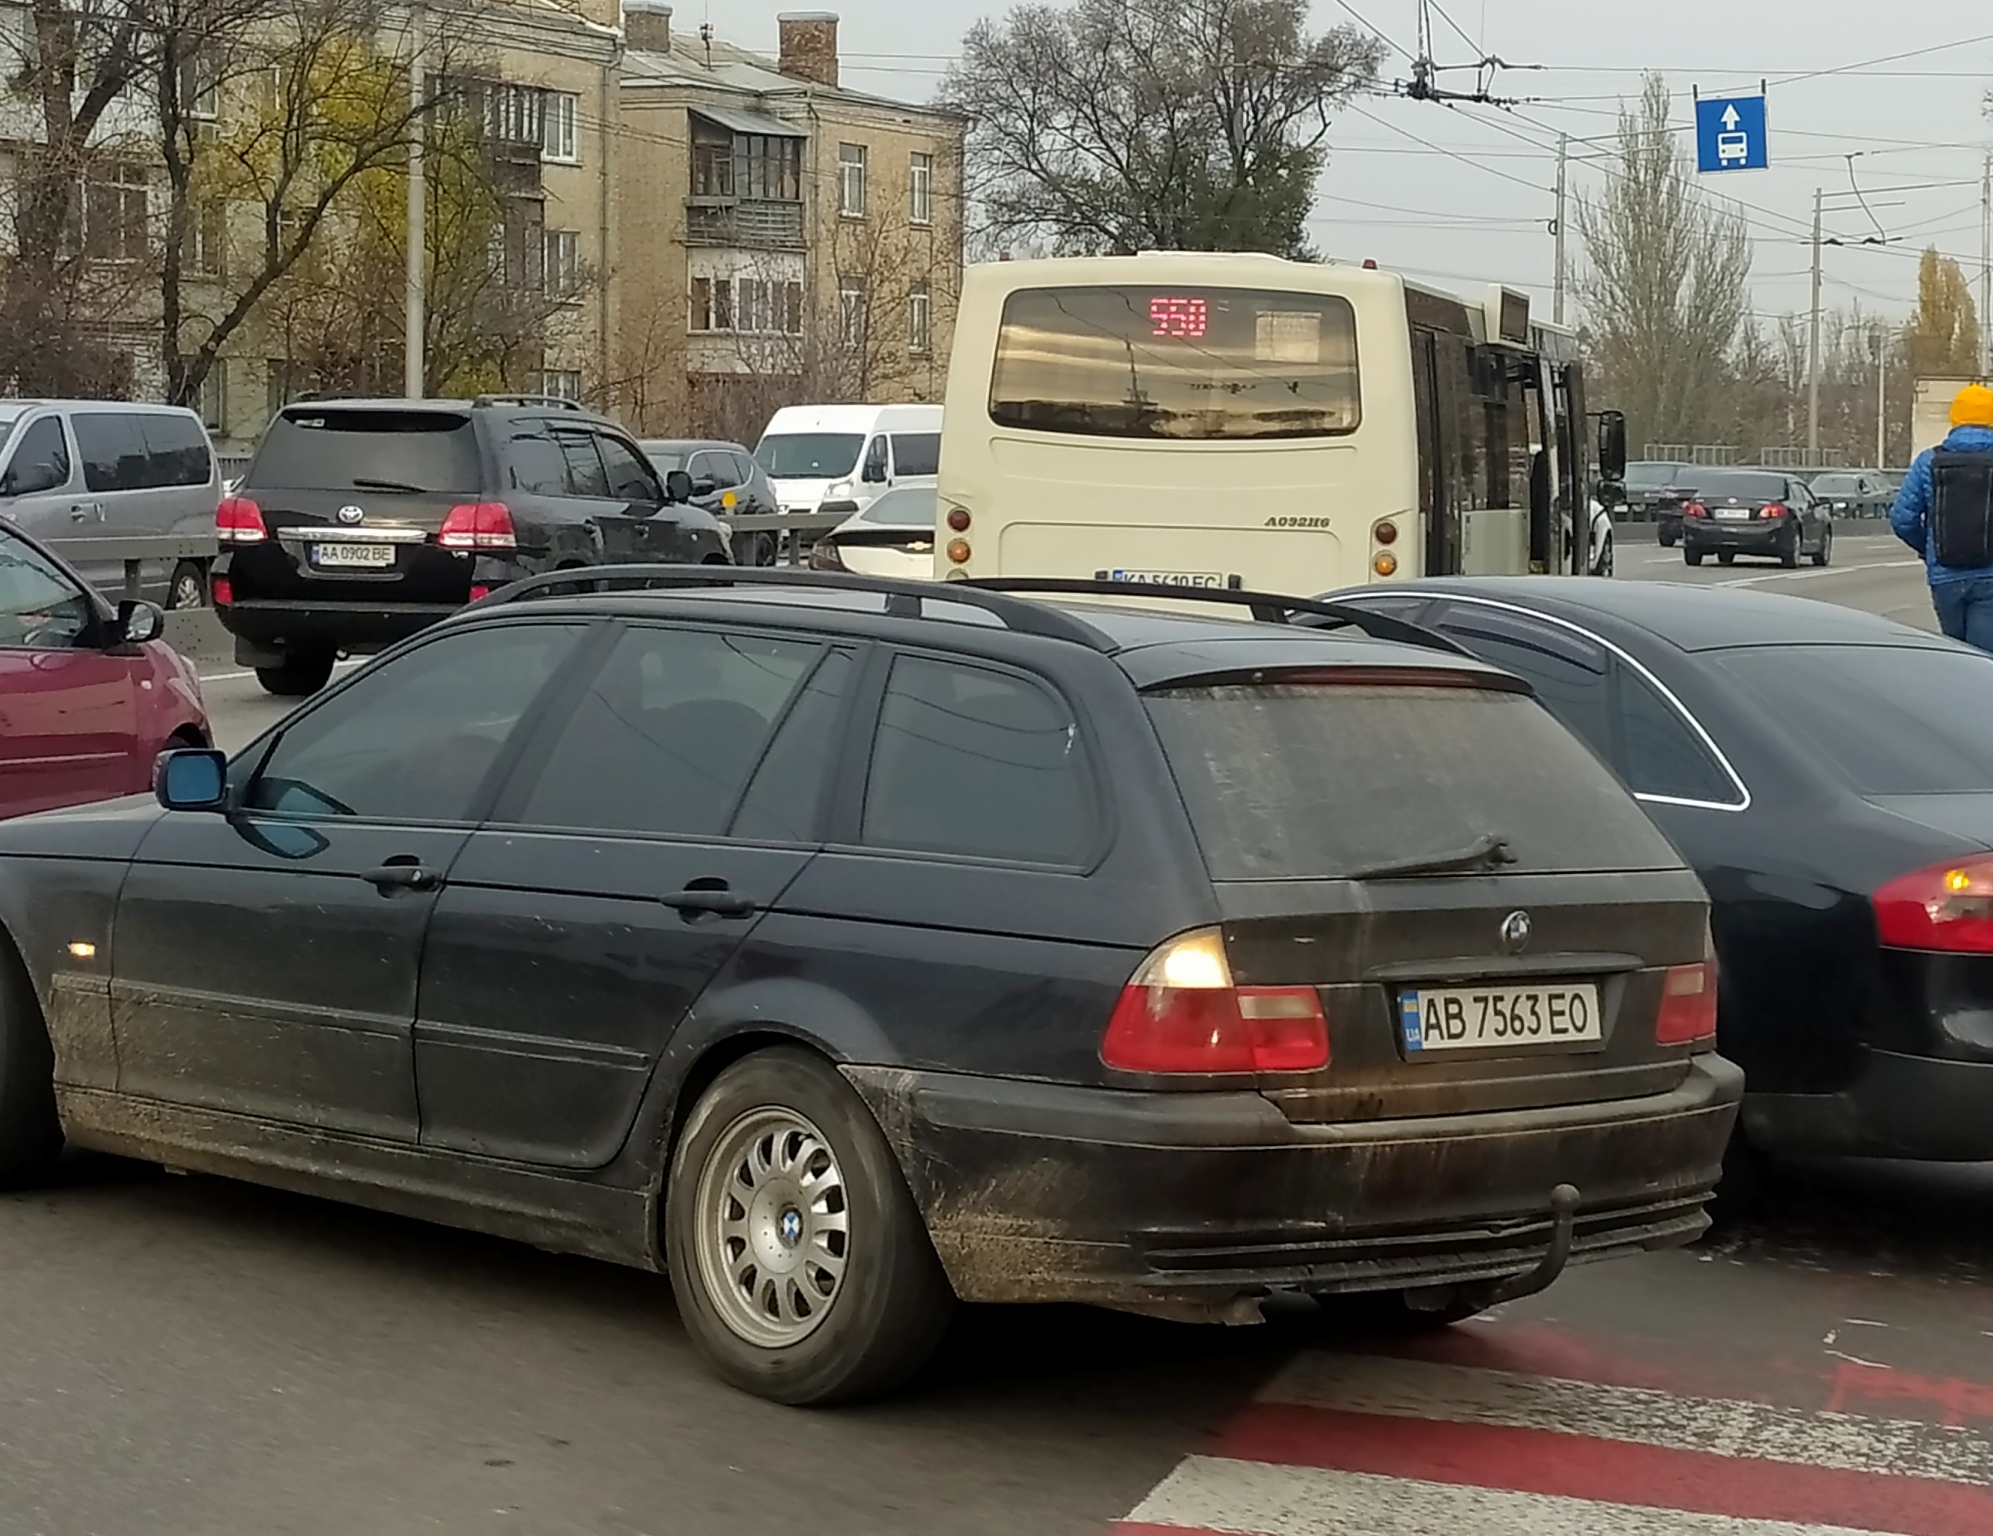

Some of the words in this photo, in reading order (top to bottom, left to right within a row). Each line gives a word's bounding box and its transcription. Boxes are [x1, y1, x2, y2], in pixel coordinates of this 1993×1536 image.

[1150, 298, 1206, 336] 550
[321, 546, 338, 560] AA
[341, 547, 371, 560] 0902
[372, 547, 391, 561] BE
[1424, 998, 1466, 1041] AB
[1473, 994, 1541, 1039] 7563
[1548, 992, 1588, 1035] EO
